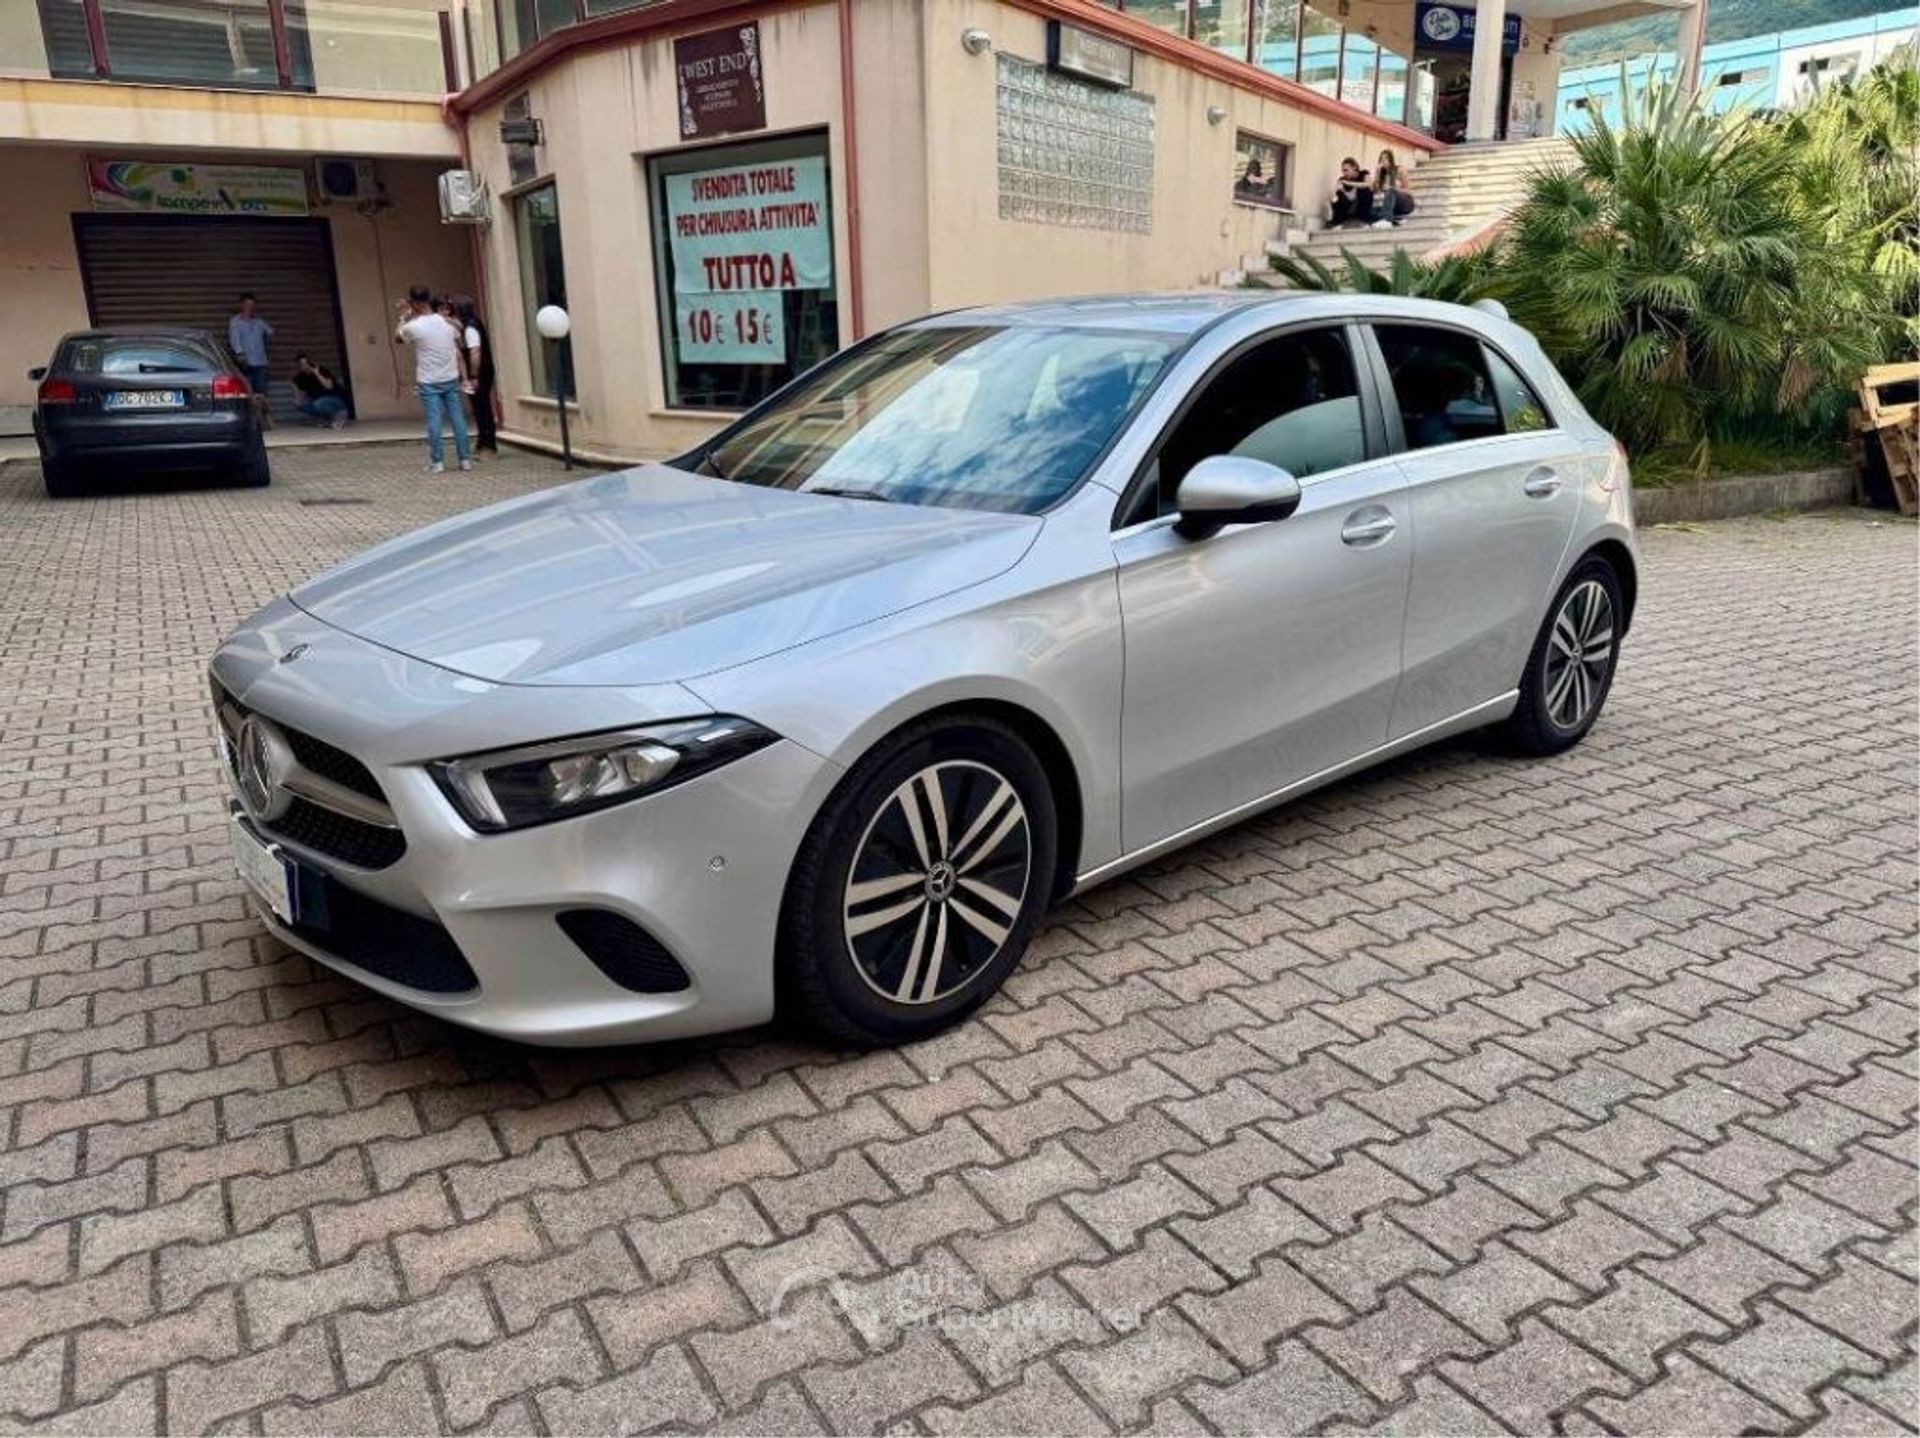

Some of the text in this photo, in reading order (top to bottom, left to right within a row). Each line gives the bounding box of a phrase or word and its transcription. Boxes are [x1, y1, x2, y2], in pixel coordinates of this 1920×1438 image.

[684, 52, 746, 78] WEST END
[692, 167, 795, 202] SVENDITA TOTALE
[676, 213, 697, 238] PER
[697, 208, 757, 236] CHIUSURA
[703, 252, 796, 290] TUTTO A
